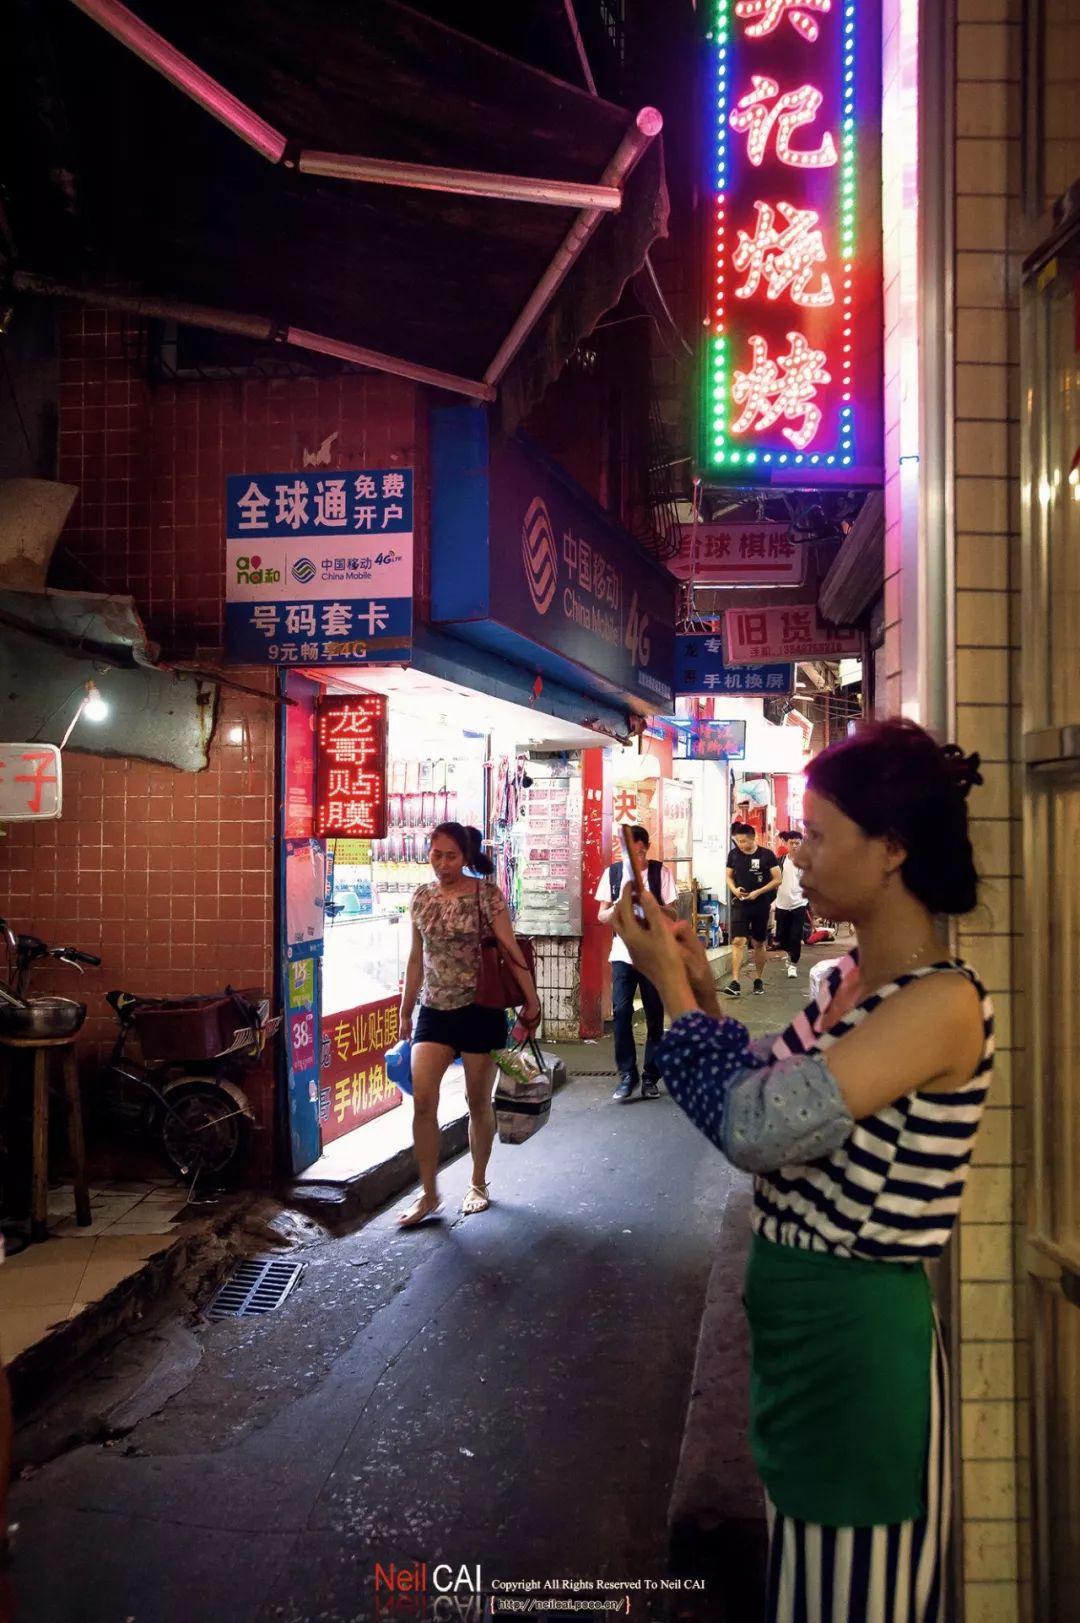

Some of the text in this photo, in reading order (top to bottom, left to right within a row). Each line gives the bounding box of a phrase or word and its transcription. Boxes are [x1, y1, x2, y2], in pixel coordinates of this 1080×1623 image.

[237, 479, 348, 529] 全球通
[354, 473, 405, 500] 免费
[353, 503, 403, 530] 开户
[321, 557, 373, 571] 中国移动
[321, 571, 372, 581] China Mobile
[563, 528, 619, 610] 中国移动
[250, 601, 390, 638] 号码套卡
[563, 587, 591, 629] China
[624, 591, 650, 667] 4G
[703, 673, 784, 689] 手机换屏
[327, 705, 376, 829] 龙哥贴膜
[293, 1020, 309, 1049] 38
[334, 1004, 398, 1062] 专业贴膜
